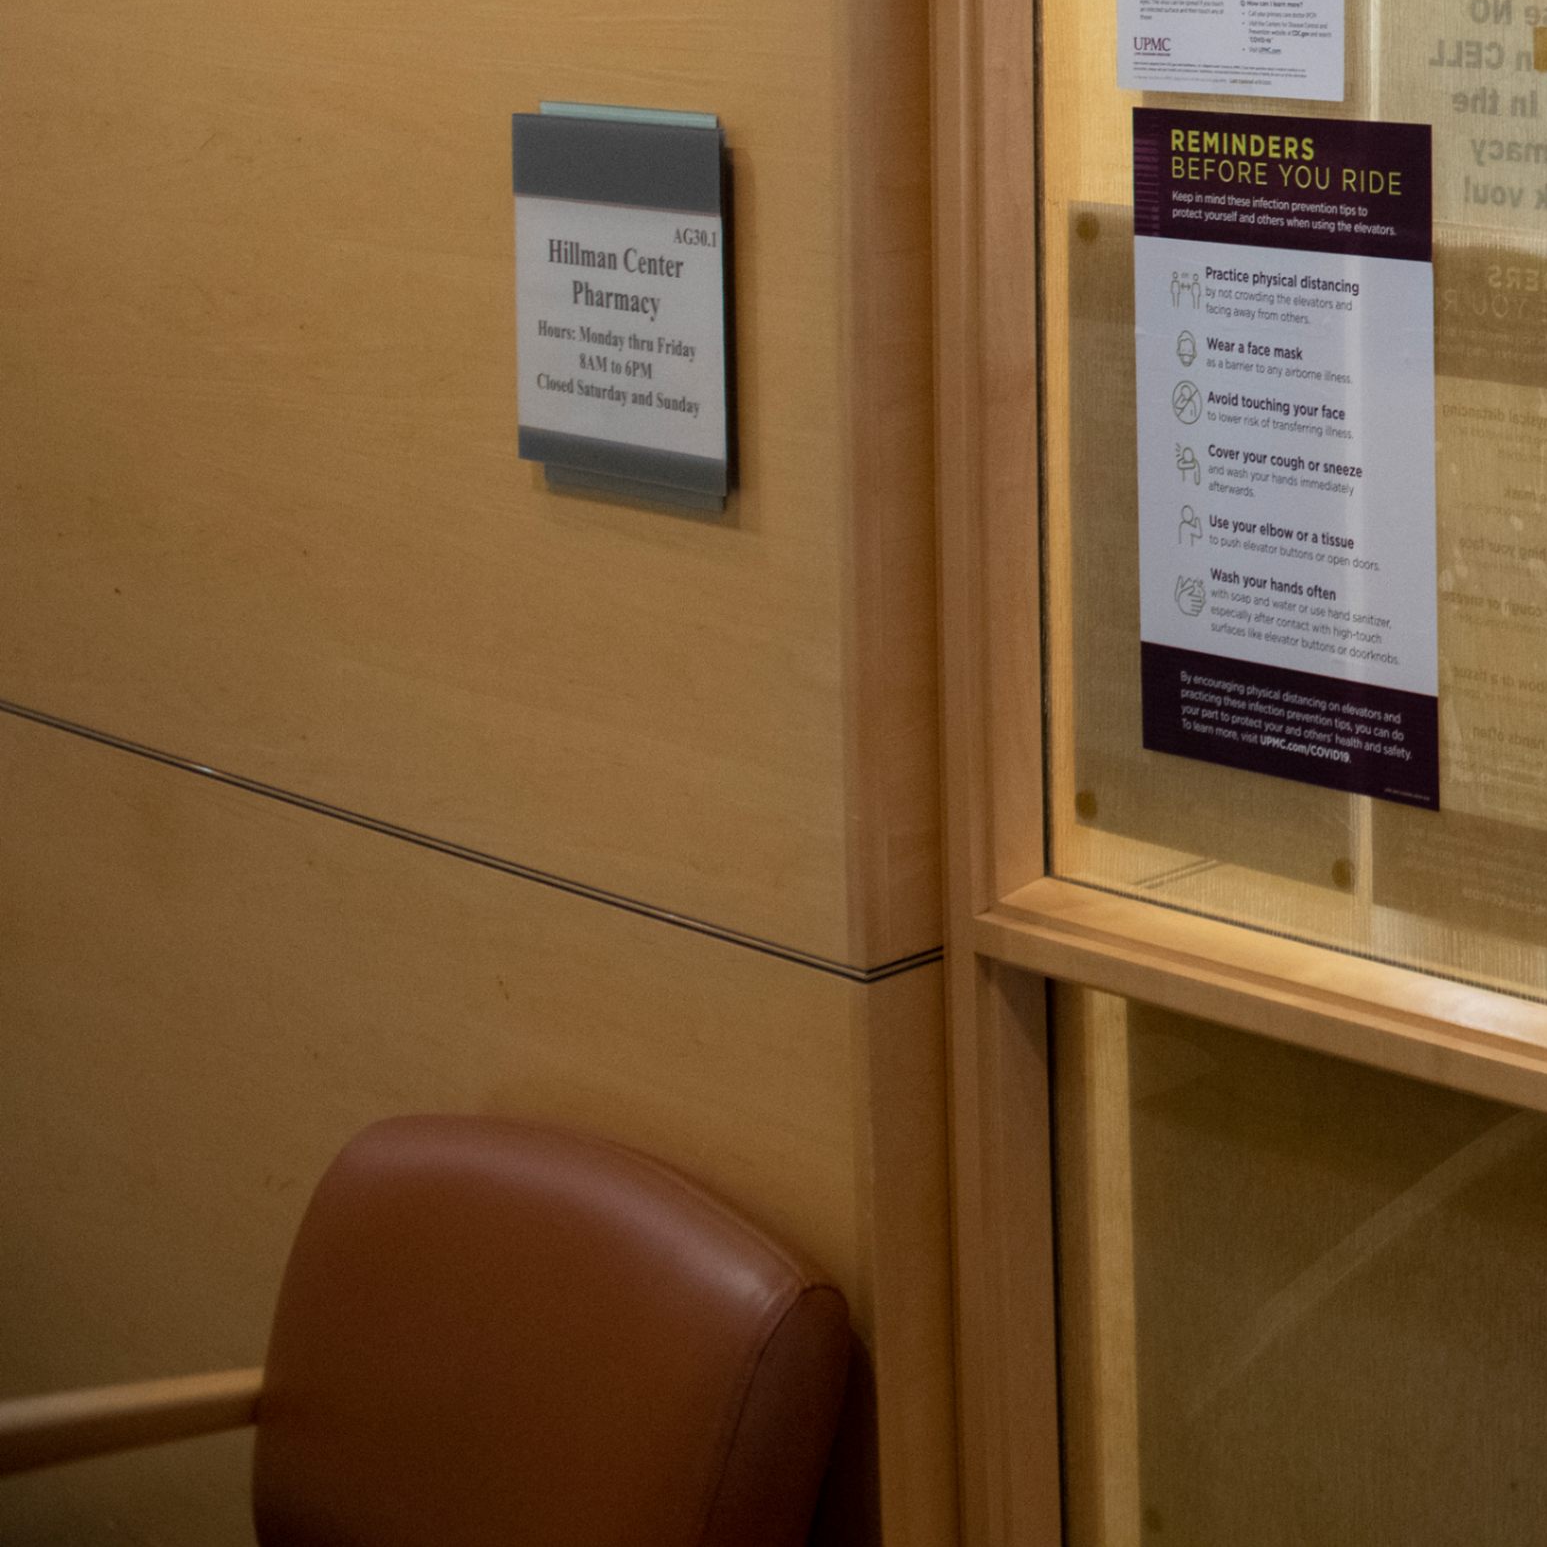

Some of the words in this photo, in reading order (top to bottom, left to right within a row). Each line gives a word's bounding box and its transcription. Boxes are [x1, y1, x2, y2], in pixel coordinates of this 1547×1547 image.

[1133, 37, 1172, 51] UPMC
[1171, 129, 1315, 161] REMINDERS
[1172, 157, 1268, 186] BEFORE
[1279, 165, 1330, 190] YOU
[1342, 169, 1402, 195] RIDE
[1172, 191, 1193, 202] Keep
[1196, 193, 1203, 202] in
[1205, 194, 1226, 205] mind
[1227, 195, 1250, 207] these
[1253, 197, 1289, 211] infection
[1291, 202, 1337, 214] prevention
[1340, 204, 1356, 216] tips
[1358, 207, 1368, 217] to
[1173, 208, 1202, 218] protect
[1205, 211, 1238, 222] yourself
[1239, 214, 1255, 223] and
[1257, 215, 1285, 226] others
[1287, 217, 1310, 228] when
[1312, 219, 1335, 232] using
[1338, 221, 1352, 232] the
[674, 228, 717, 248] AG30.1
[549, 239, 617, 270] Hillman
[623, 248, 684, 278] Center
[1206, 266, 1249, 283] Practice
[1252, 271, 1297, 289] physical
[1301, 278, 1360, 296] distancing
[572, 280, 661, 322] Pharmacy
[538, 320, 576, 341] Hours:
[579, 326, 625, 351] Monday
[628, 335, 654, 351] thru
[658, 337, 696, 362] Friday
[1207, 337, 1236, 353] Wear
[1238, 343, 1245, 354] a
[1247, 342, 1271, 357] face
[1274, 345, 1303, 360] mask
[579, 353, 607, 373] 8AM
[611, 360, 622, 375] to
[625, 360, 653, 379] 6PM
[537, 373, 574, 393] Closed
[577, 379, 627, 406] Saturday
[632, 391, 653, 406] and
[657, 393, 699, 419] Sunday
[1208, 391, 1238, 407] Avoid
[1241, 395, 1290, 415] touching
[1293, 404, 1320, 420] your
[1322, 406, 1346, 420] face
[1208, 444, 1240, 460] Cover
[1243, 450, 1267, 466] your
[1271, 454, 1305, 472] cough
[1308, 459, 1321, 471] or
[1324, 461, 1363, 478] sneeze
[1210, 514, 1229, 530] Use
[1232, 520, 1257, 534] your
[1260, 523, 1293, 539] elbow
[1297, 530, 1309, 542] or
[1311, 533, 1319, 543] a
[1321, 532, 1354, 549] tissue
[1211, 568, 1240, 585] Wash
[1243, 575, 1267, 590] your
[1270, 579, 1303, 597] hands
[1307, 586, 1336, 601] often
[1182, 718, 1191, 730] To
[1193, 721, 1213, 734] learn
[1241, 733, 1258, 744] visit
